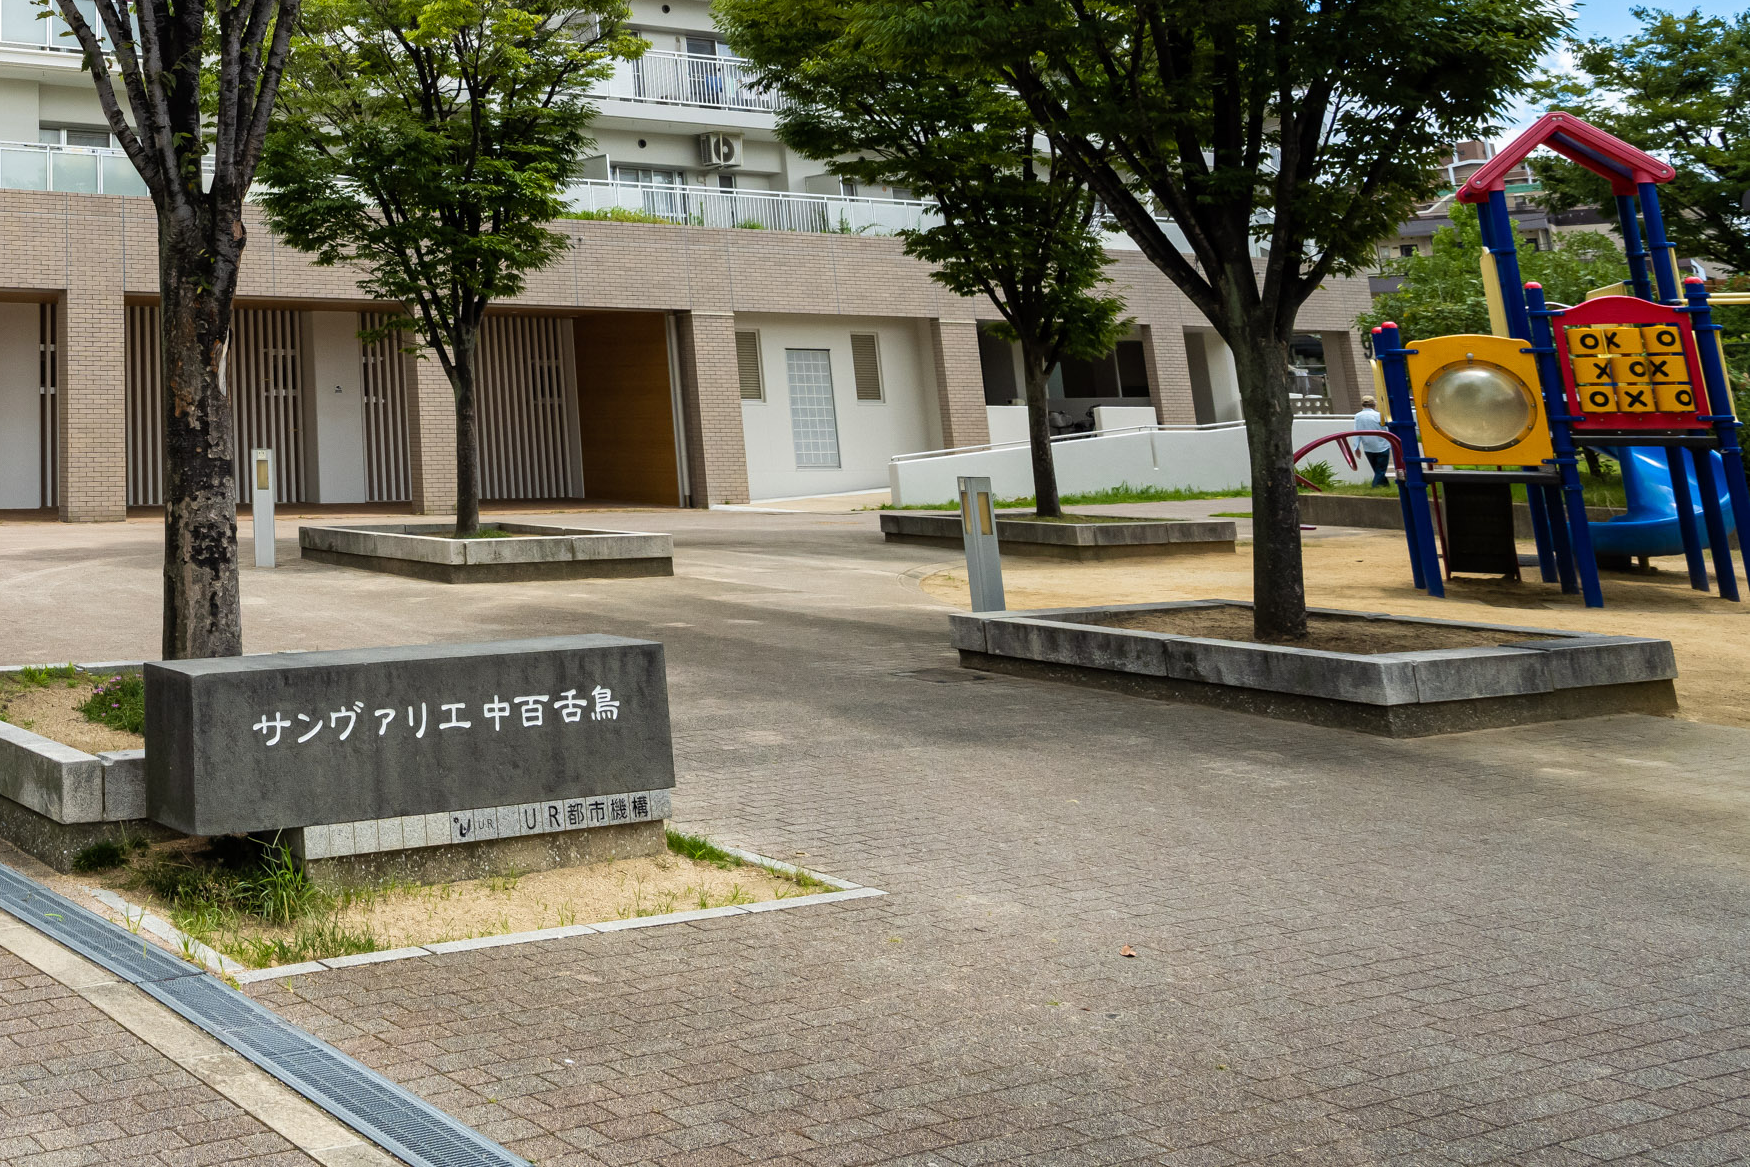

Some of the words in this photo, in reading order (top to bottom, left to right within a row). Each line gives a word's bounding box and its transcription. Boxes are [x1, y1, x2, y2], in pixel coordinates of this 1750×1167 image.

[252, 685, 621, 746] サンヴァリエ中百舌鳥
[477, 818, 493, 830] UR
[524, 795, 649, 830] UR都市機構
